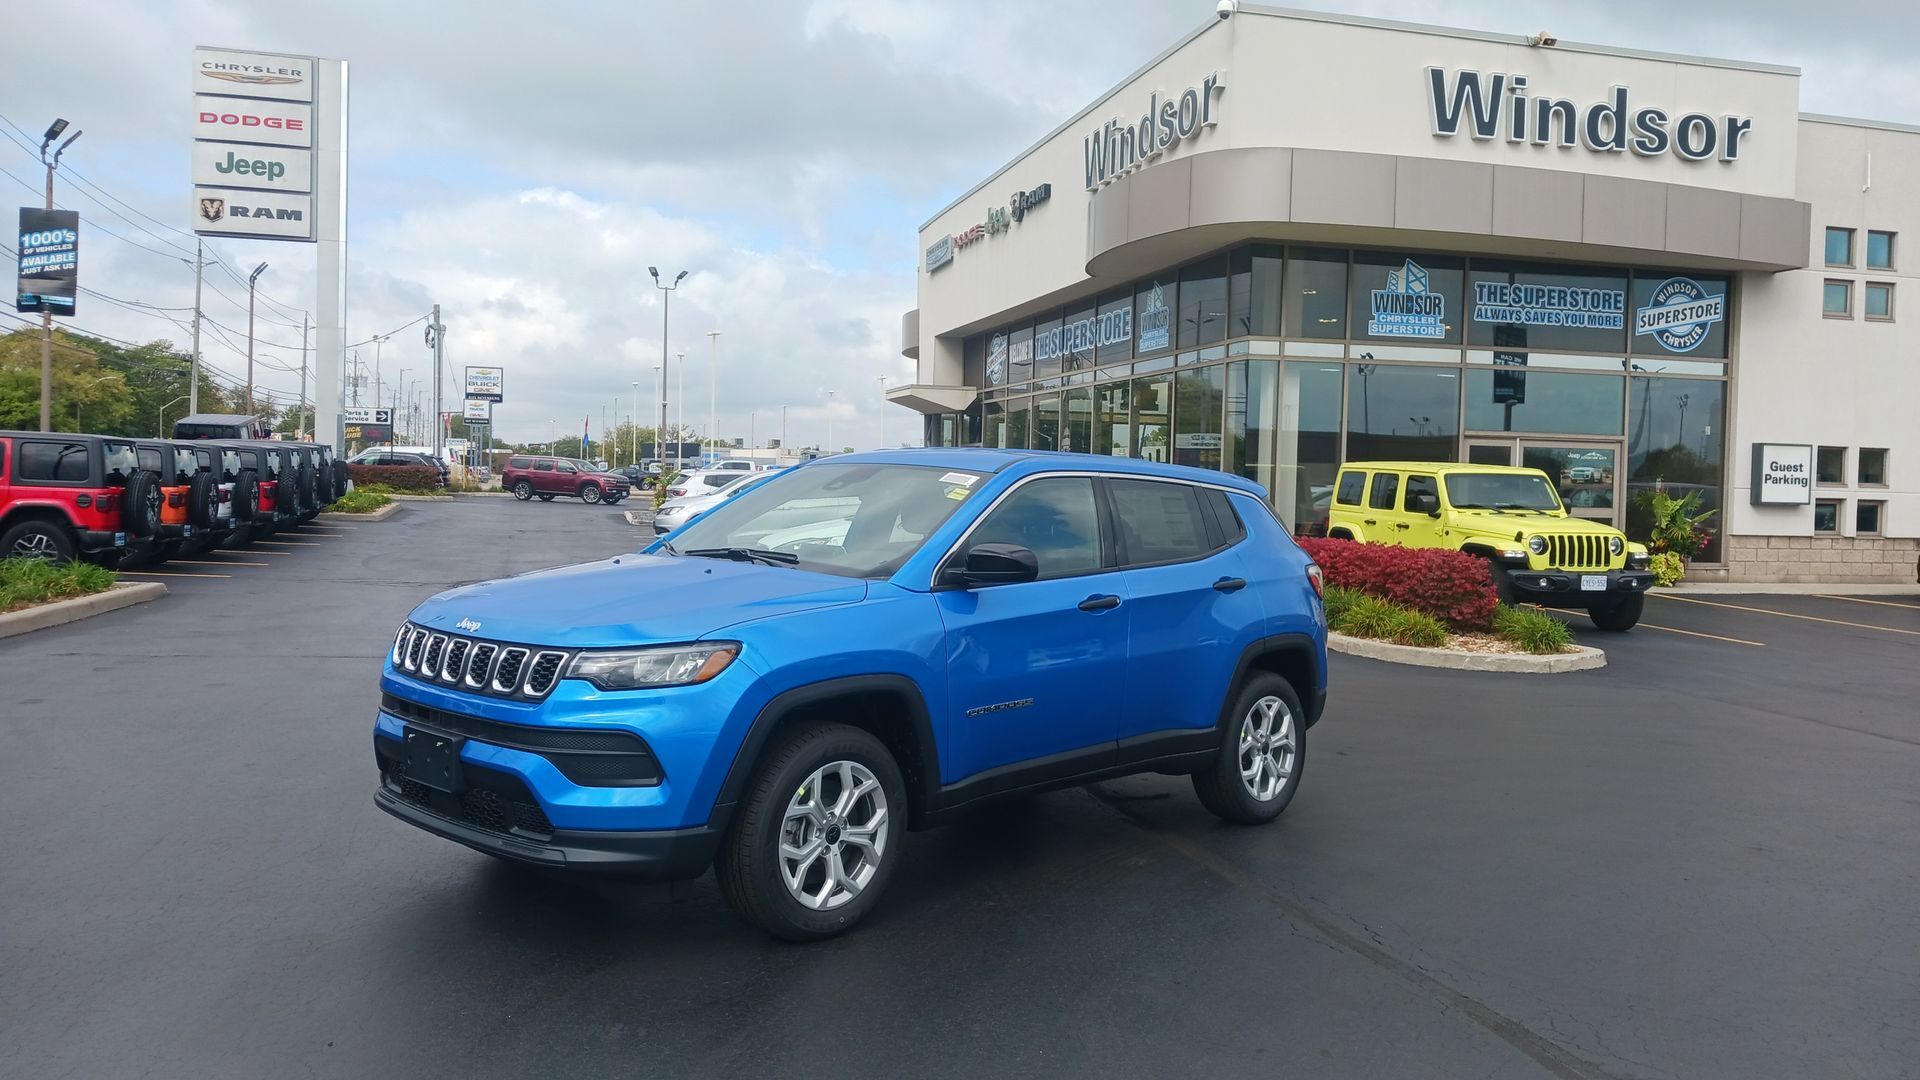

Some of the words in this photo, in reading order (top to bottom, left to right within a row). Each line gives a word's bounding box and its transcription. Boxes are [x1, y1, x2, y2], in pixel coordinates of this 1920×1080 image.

[201, 62, 302, 77] CHRYSLER
[199, 112, 303, 131] DODGE
[1424, 65, 1753, 162] Windsor
[1084, 70, 1225, 192] Windsor
[215, 151, 285, 181] Jeep
[1020, 183, 1051, 210] RAM
[229, 205, 303, 221] RAM
[21, 229, 76, 247] 1000's
[23, 247, 34, 255] OF
[35, 243, 73, 253] VEHICLES
[21, 252, 76, 268] AVAILABLE
[21, 266, 41, 275] JUST
[43, 264, 61, 272] ASK
[1476, 283, 1509, 304] THE
[1511, 283, 1623, 312] SUPERSTORE
[1657, 283, 1698, 303] WINDSOR
[1374, 293, 1442, 316] WINDSOR
[1380, 315, 1435, 325] CHRYSLER
[1476, 307, 1522, 322] ALWAYS
[1525, 309, 1561, 324] SAVES
[1564, 313, 1585, 327] YOU
[1588, 315, 1622, 328] MORE!
[1640, 302, 1720, 329] SUPERSTORE
[1035, 332, 1049, 360] THE
[1050, 306, 1132, 358] SUPERSTORE
[1371, 324, 1443, 335] SUPERSTORE
[1663, 326, 1704, 347] CHRYSLER
[1770, 461, 1804, 473] Guest
[1764, 473, 1808, 488] Parking
[456, 617, 482, 633] Jeep
